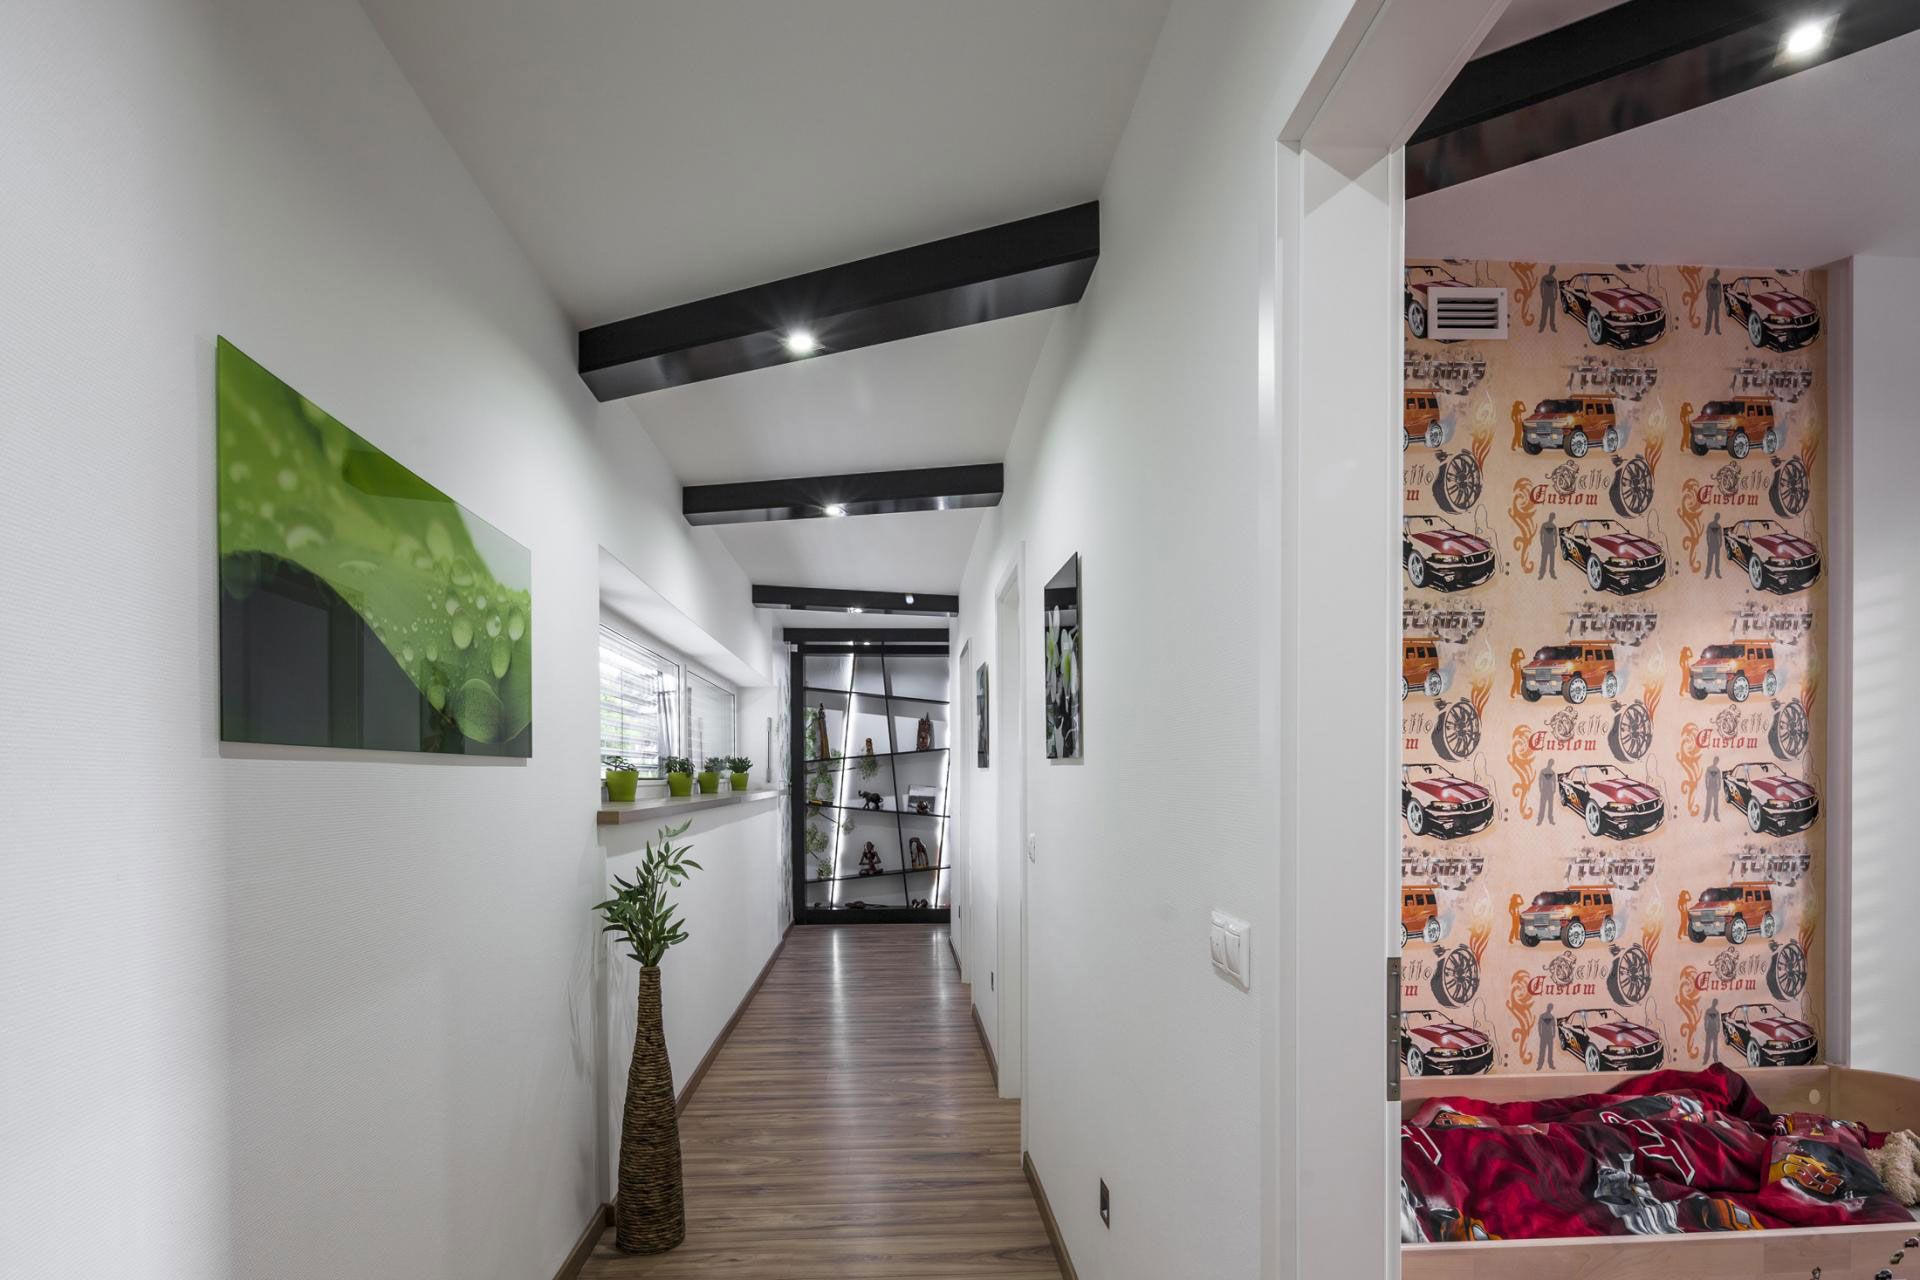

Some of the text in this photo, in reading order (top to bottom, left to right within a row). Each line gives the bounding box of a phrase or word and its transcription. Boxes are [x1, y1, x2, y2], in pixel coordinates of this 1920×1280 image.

[1529, 485, 1597, 505] Custom
[1697, 485, 1758, 505] Custom
[1528, 731, 1596, 751] Custom
[1696, 729, 1757, 748] Custom
[1527, 976, 1596, 995] Custom
[1695, 972, 1755, 991] Custom
